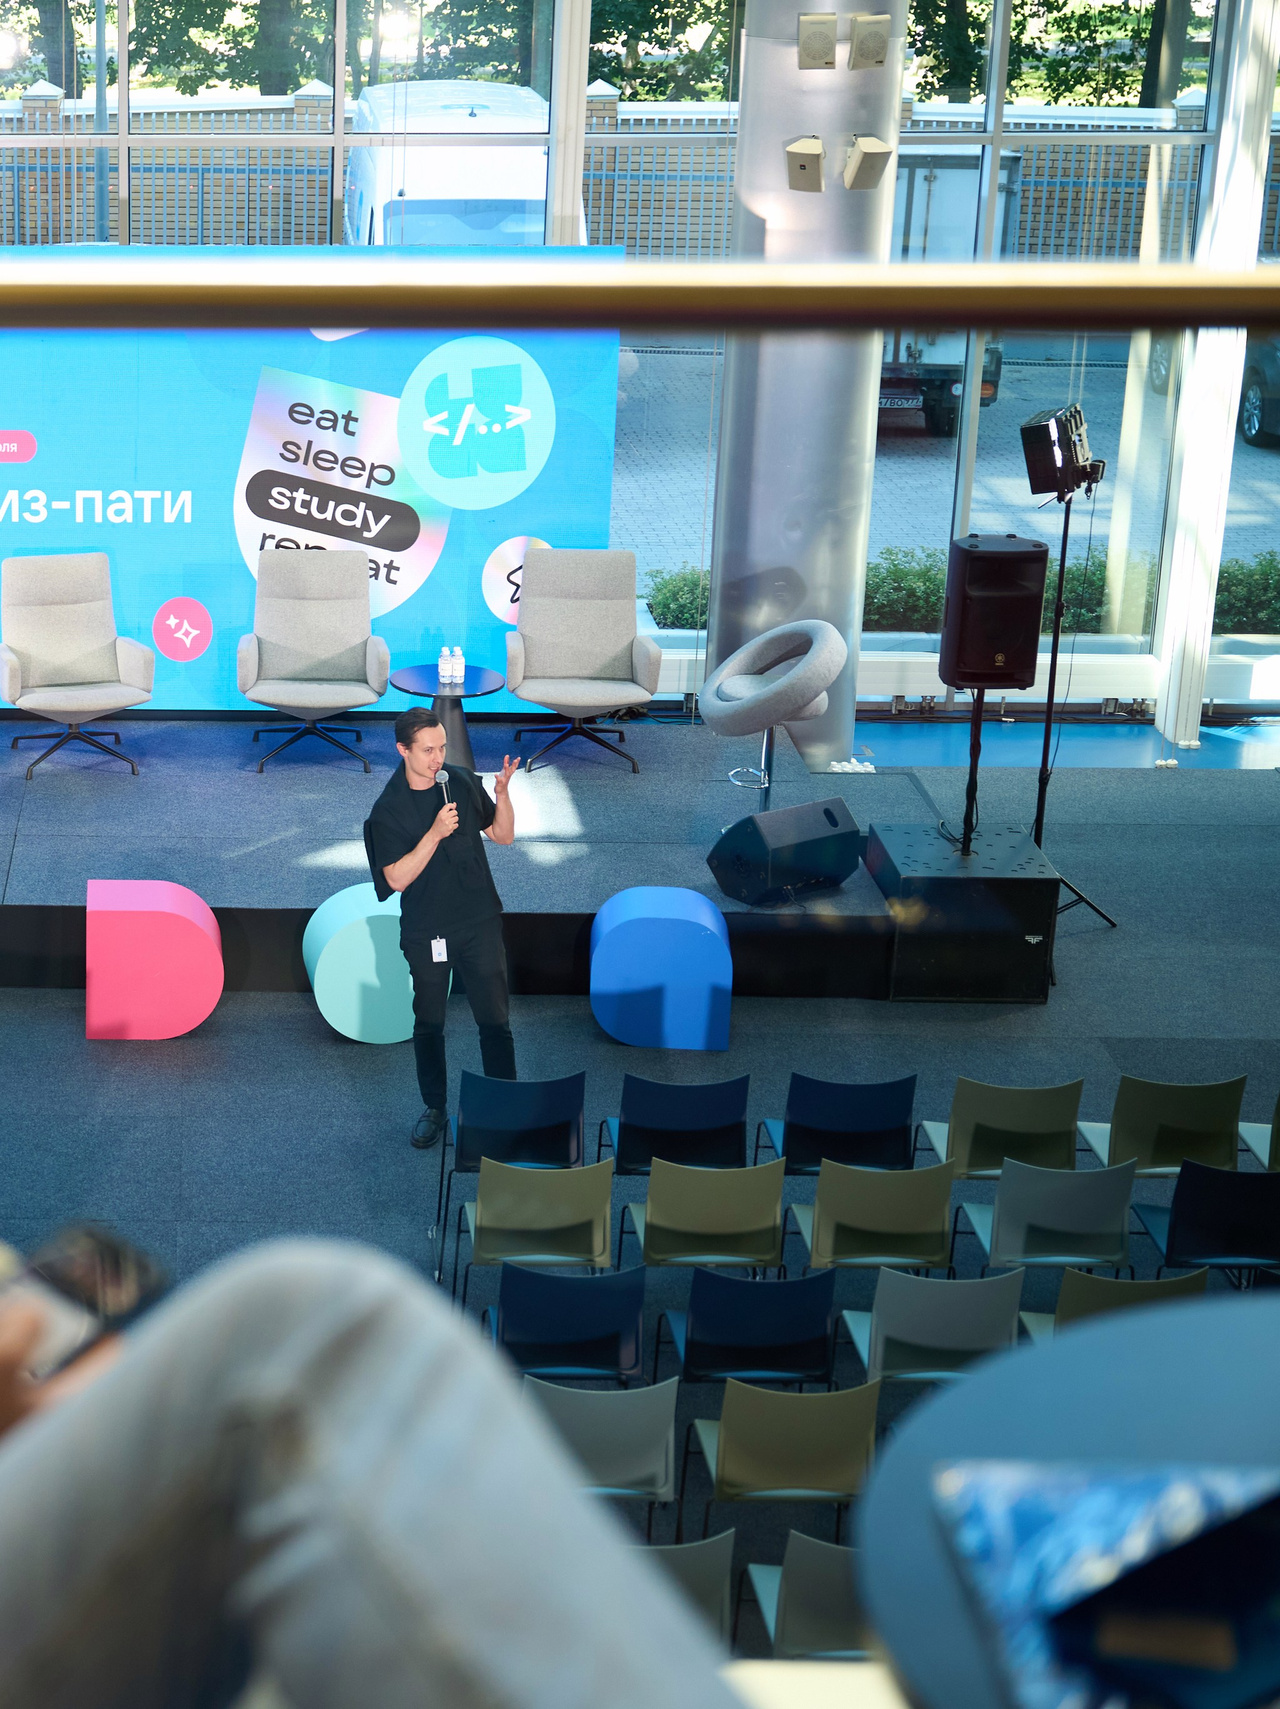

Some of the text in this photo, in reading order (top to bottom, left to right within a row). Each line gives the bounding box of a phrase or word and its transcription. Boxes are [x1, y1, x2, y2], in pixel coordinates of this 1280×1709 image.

[288, 402, 359, 437] eat
[278, 439, 396, 489] sleep
[268, 486, 392, 538] study
